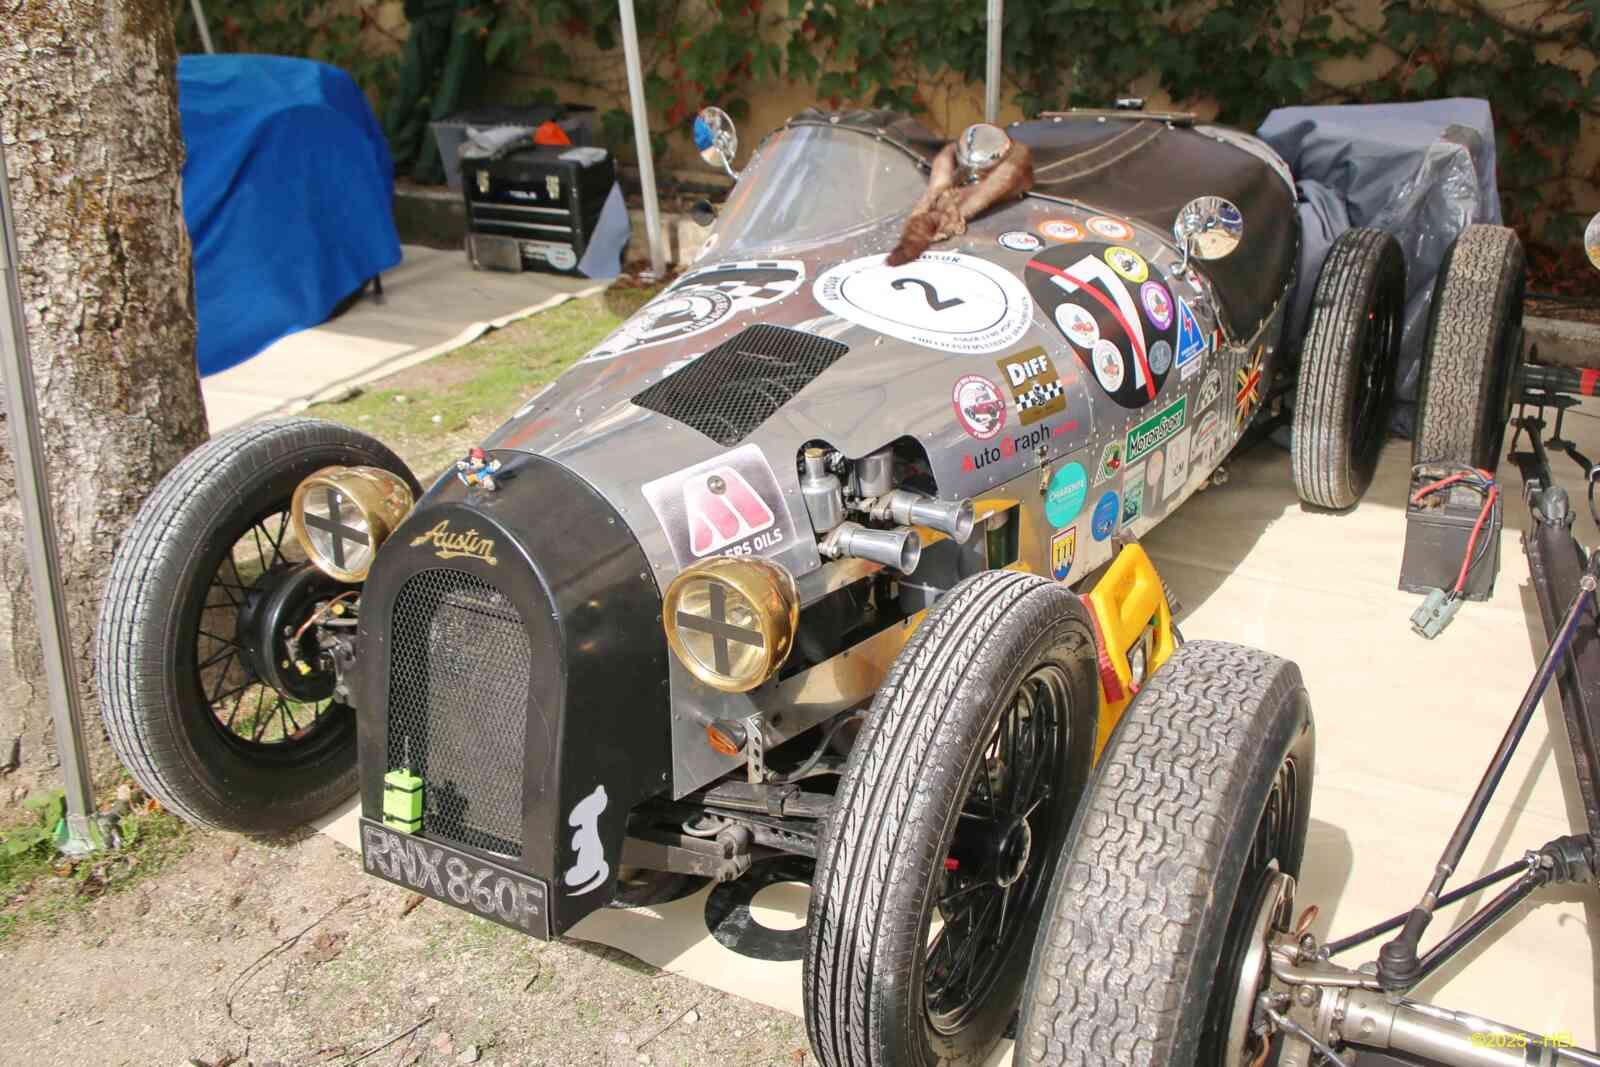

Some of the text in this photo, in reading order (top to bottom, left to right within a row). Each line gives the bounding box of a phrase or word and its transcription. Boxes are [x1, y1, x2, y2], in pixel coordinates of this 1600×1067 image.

[891, 278, 966, 311] 2
[1006, 355, 1048, 387] DIFF
[409, 520, 497, 566] Austin
[754, 528, 783, 551] OILS
